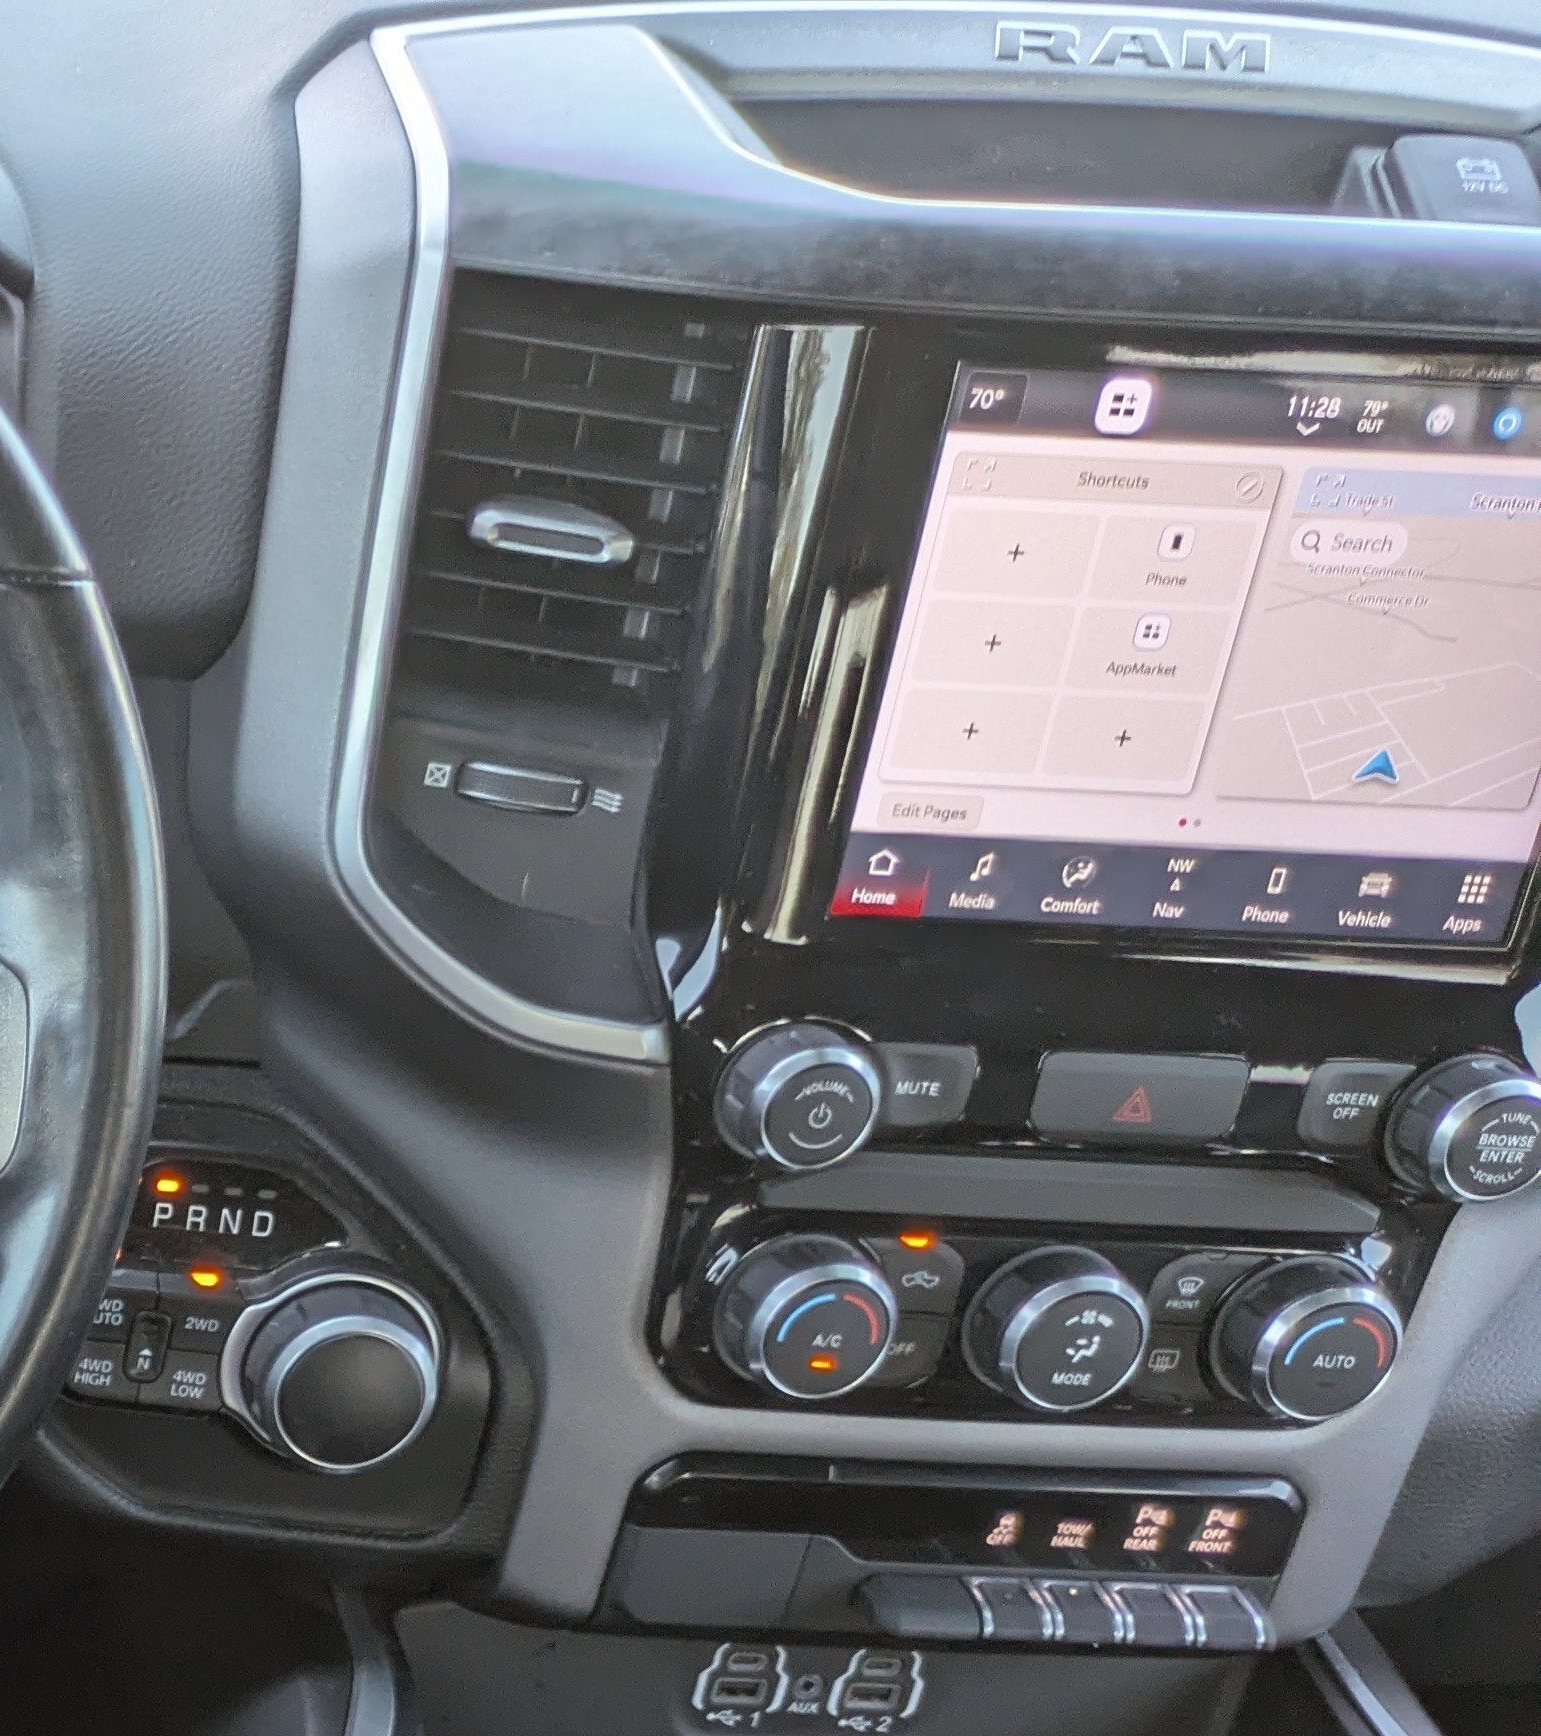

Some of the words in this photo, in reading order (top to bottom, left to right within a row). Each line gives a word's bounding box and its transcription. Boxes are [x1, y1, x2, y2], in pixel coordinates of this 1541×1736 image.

[994, 20, 1271, 74] RAM
[968, 387, 1005, 410] 70°
[1288, 394, 1342, 419] 11:28
[1356, 419, 1384, 434] OUT
[1077, 471, 1150, 491] Shortcuts
[1330, 532, 1394, 555] Search
[1362, 564, 1425, 579] Connector
[1145, 572, 1187, 588] Phone
[1348, 592, 1412, 607] Commerce
[1105, 660, 1177, 678] AppMarket
[892, 803, 920, 818] Edit
[923, 805, 968, 822] Pages
[1167, 858, 1196, 874] NW
[851, 887, 896, 905] Home
[949, 891, 996, 910] Media
[1040, 896, 1102, 915] Comfort
[1152, 901, 1185, 919] Nav
[1241, 904, 1290, 924] Phone
[1337, 909, 1392, 929] Vehicle
[1442, 914, 1483, 934] Apps
[804, 1080, 848, 1097] VOLUME
[895, 1080, 940, 1097] MUTE
[1326, 1093, 1379, 1108] SCREEN
[1333, 1107, 1360, 1120] OFF
[1501, 1112, 1532, 1125] TUNE
[1478, 1132, 1536, 1148] BROWSE
[1480, 1150, 1525, 1164] ENTER
[1473, 1169, 1515, 1184] SCROLL
[153, 1202, 174, 1228] P
[186, 1205, 209, 1231] R
[219, 1208, 242, 1234] N
[251, 1210, 276, 1238] D
[98, 1299, 125, 1312] WD
[184, 1316, 219, 1332] 2WD
[812, 1333, 842, 1348] A/C
[78, 1358, 114, 1373] 4WD
[136, 1357, 151, 1370] N
[1312, 1353, 1356, 1369] AUTO
[74, 1371, 113, 1387] HIGH
[172, 1370, 208, 1385] 4WD
[1051, 1372, 1092, 1386] MODE
[170, 1384, 205, 1399] LOW
[1132, 1525, 1159, 1538] OFF
[1202, 1528, 1229, 1540] OFF
[1050, 1535, 1087, 1548] HAUL
[1123, 1537, 1159, 1550] REAR
[1187, 1540, 1233, 1552] FRONT
[787, 1702, 819, 1714] AUX
[750, 1711, 761, 1728] 1
[875, 1715, 893, 1733] 2
